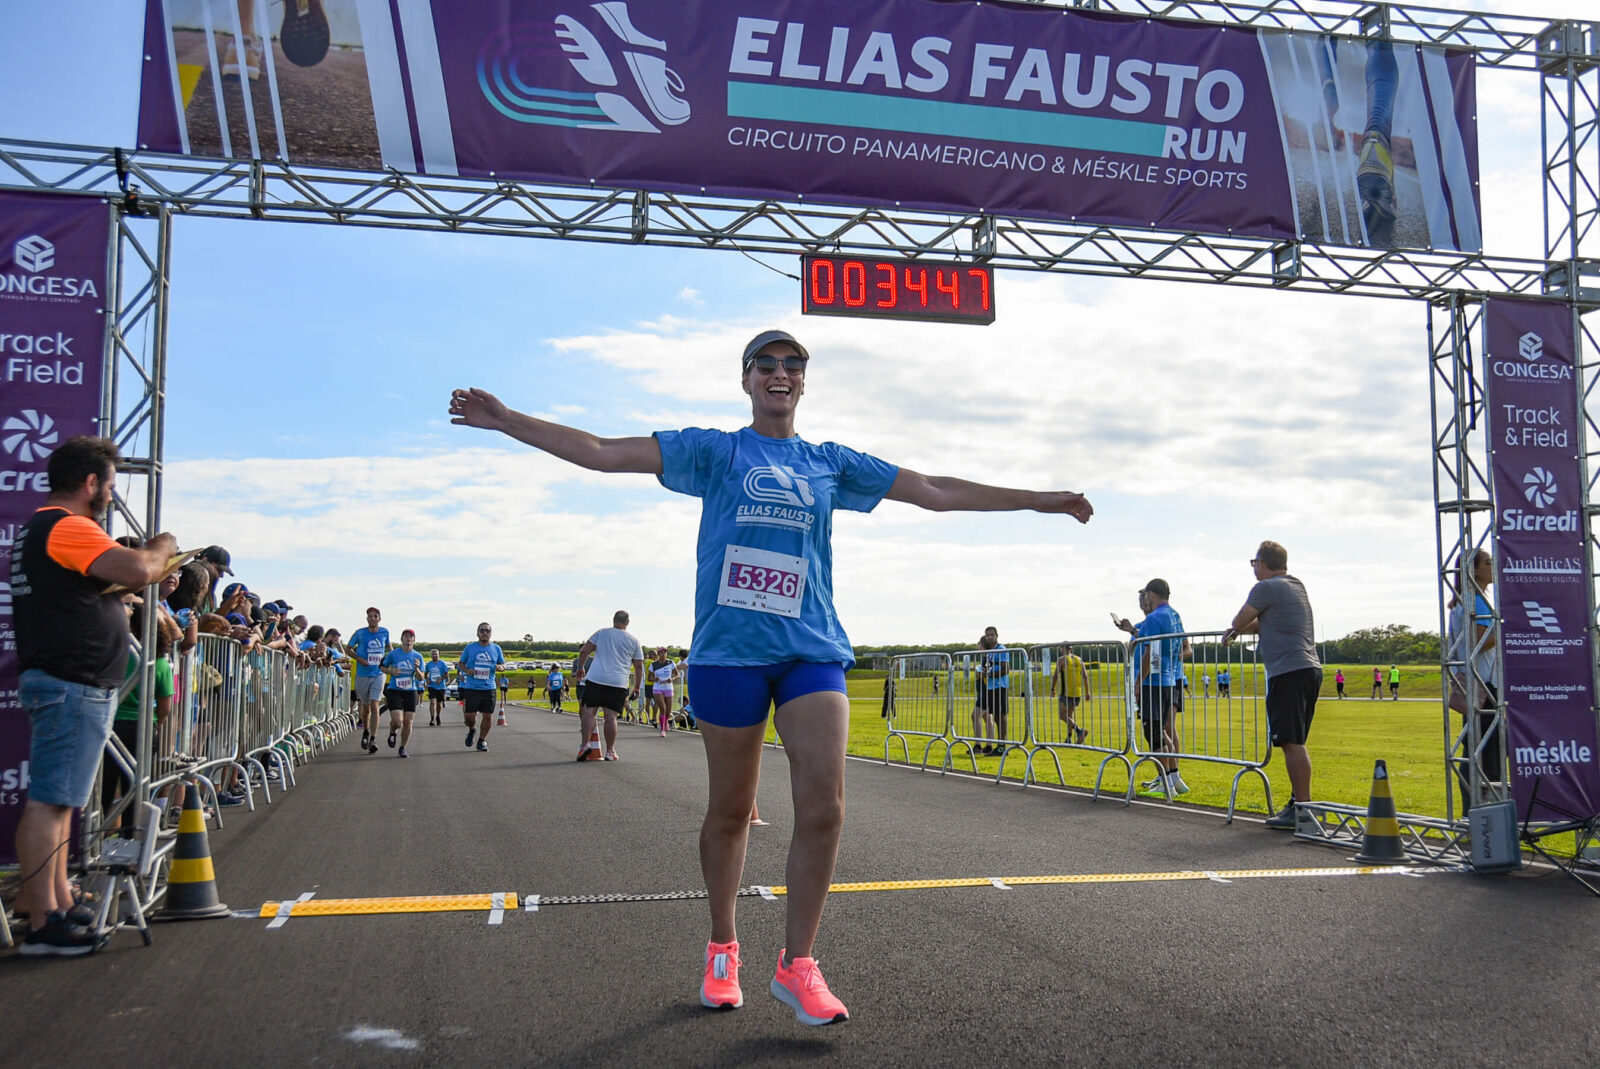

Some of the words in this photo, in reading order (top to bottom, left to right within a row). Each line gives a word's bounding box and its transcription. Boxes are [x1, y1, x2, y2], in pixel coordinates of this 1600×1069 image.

[729, 16, 952, 93] ELIAS
[969, 43, 1246, 124] FAUSTO
[1162, 124, 1247, 164] RUN
[727, 126, 846, 155] CIRCUITO
[853, 137, 1047, 172] PANAMERICANO
[1051, 156, 1065, 173] &
[1072, 155, 1159, 183] MÉSKLE
[1163, 166, 1248, 190] SPORTS
[8, 358, 84, 385] Field
[1493, 361, 1571, 379] CONGESA
[1502, 404, 1561, 425] Track
[1505, 427, 1519, 446] &
[1523, 428, 1568, 448] Field
[736, 504, 772, 516] ELIAS
[772, 506, 815, 525] FAUSTO
[1502, 508, 1577, 532] Sicredi
[1505, 556, 1581, 570] AnaliticAS
[737, 565, 796, 596] 5326
[1505, 575, 1551, 583] ASSESSORIA
[1552, 576, 1580, 584] DIGITAL
[1515, 740, 1591, 764] méskle
[1517, 764, 1561, 778] sports
